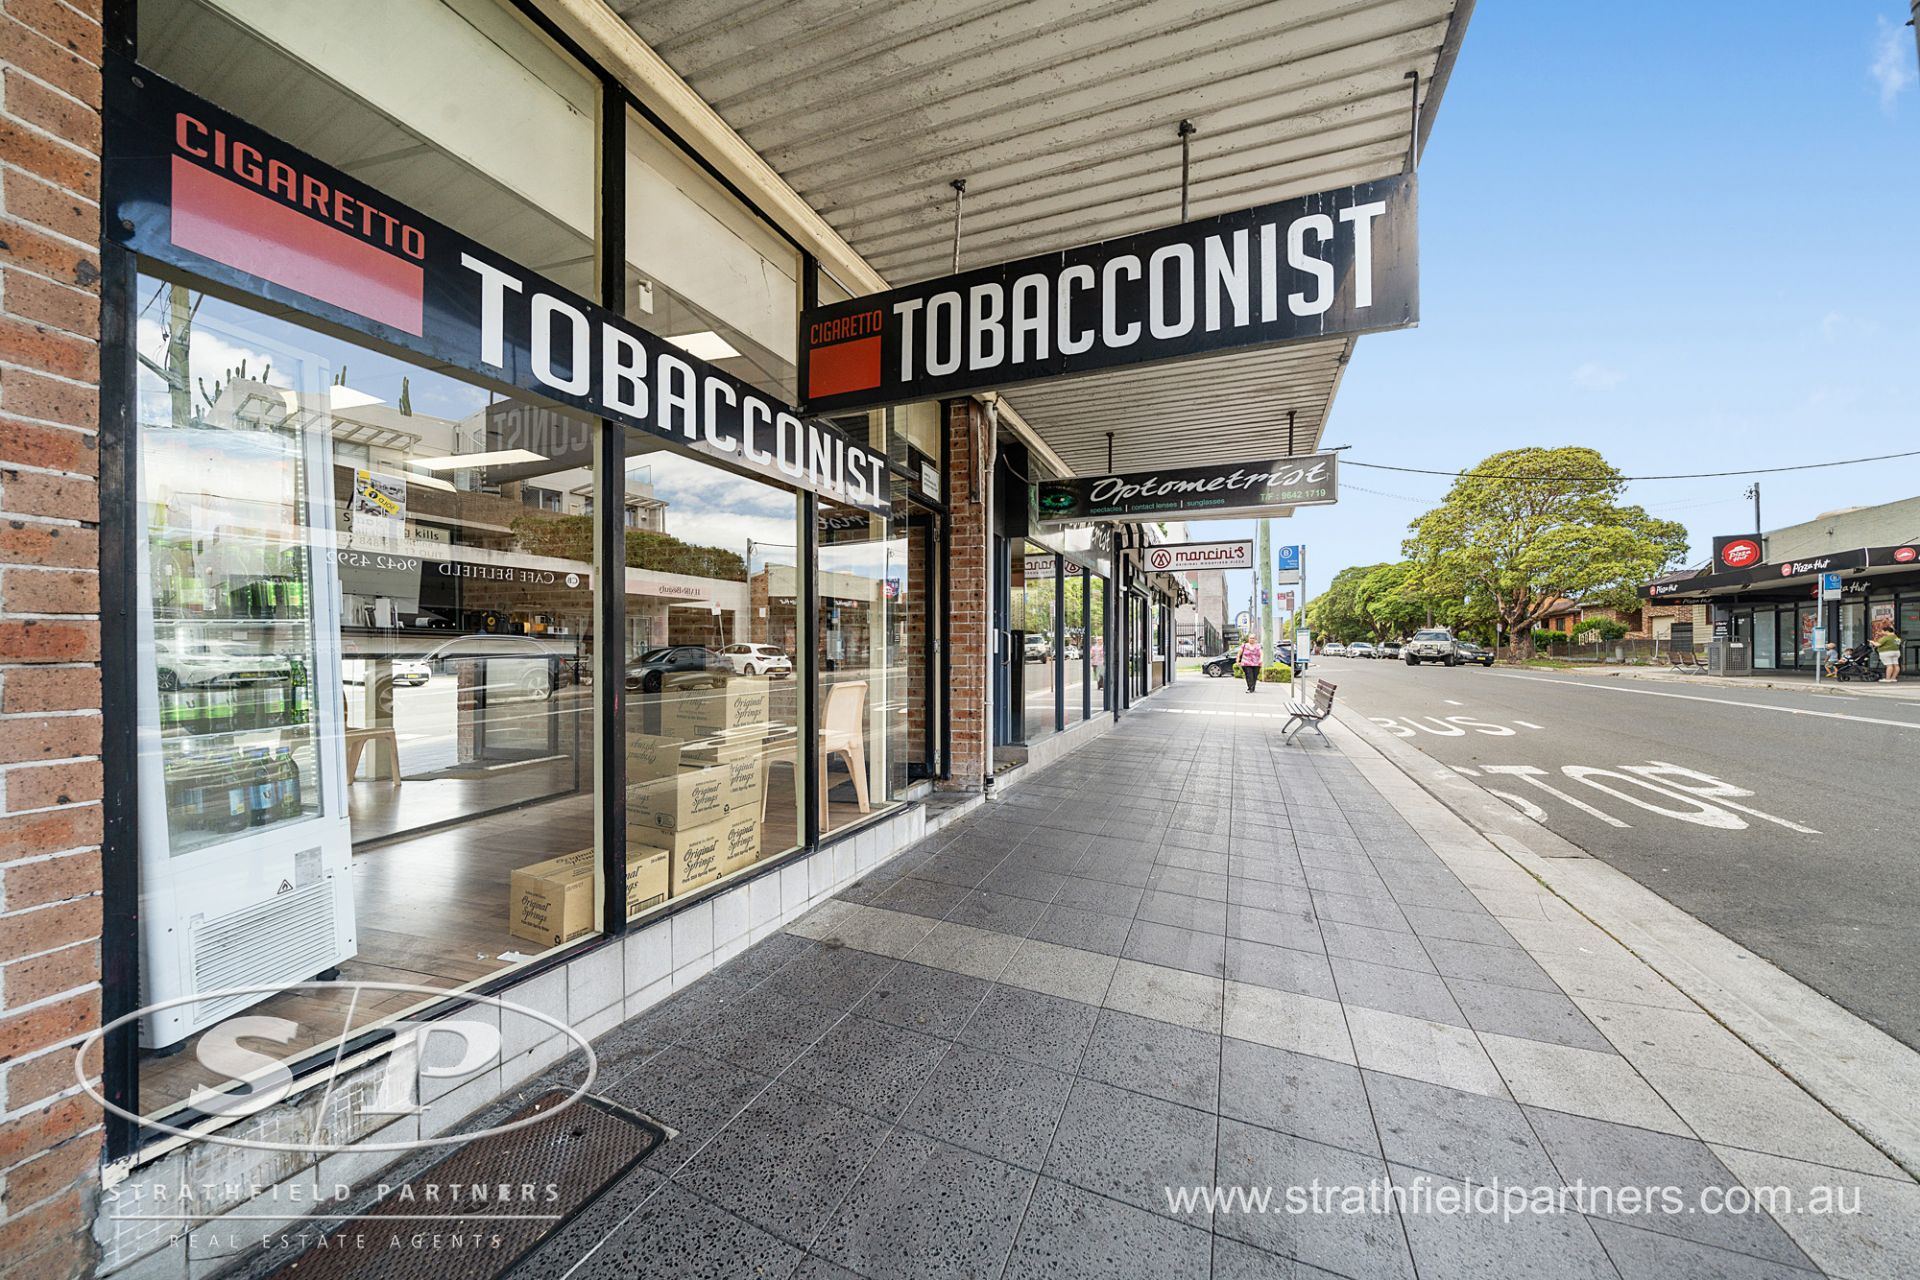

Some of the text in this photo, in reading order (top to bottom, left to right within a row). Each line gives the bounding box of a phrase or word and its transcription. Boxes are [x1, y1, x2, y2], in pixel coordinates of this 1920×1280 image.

[174, 112, 426, 260] CIGARETTO
[892, 200, 1386, 383] TOBACCONIST
[810, 309, 883, 346] CIGARETTO
[460, 252, 885, 508] TOBACCONIST
[1089, 461, 1328, 505] Optometrist
[1281, 490, 1302, 499] 9642
[1304, 488, 1327, 498] 1719
[1131, 503, 1154, 511] contact
[1186, 498, 1225, 507] sunglasses
[415, 529, 439, 540] kills
[1730, 550, 1751, 560] Pizza
[1792, 559, 1831, 574] Pizza Hut
[1850, 581, 1871, 593] Hut
[734, 696, 765, 710] Original
[735, 708, 762, 722] Springs
[1367, 716, 1516, 737] BUS
[692, 783, 721, 799] Original
[1434, 760, 1824, 834] STOP
[692, 794, 718, 810] Springs
[728, 821, 756, 841] Original
[684, 839, 719, 861] Original
[728, 835, 754, 855] Springs
[684, 855, 715, 878] Springs
[521, 896, 551, 911] Original
[522, 906, 547, 924] Springs
